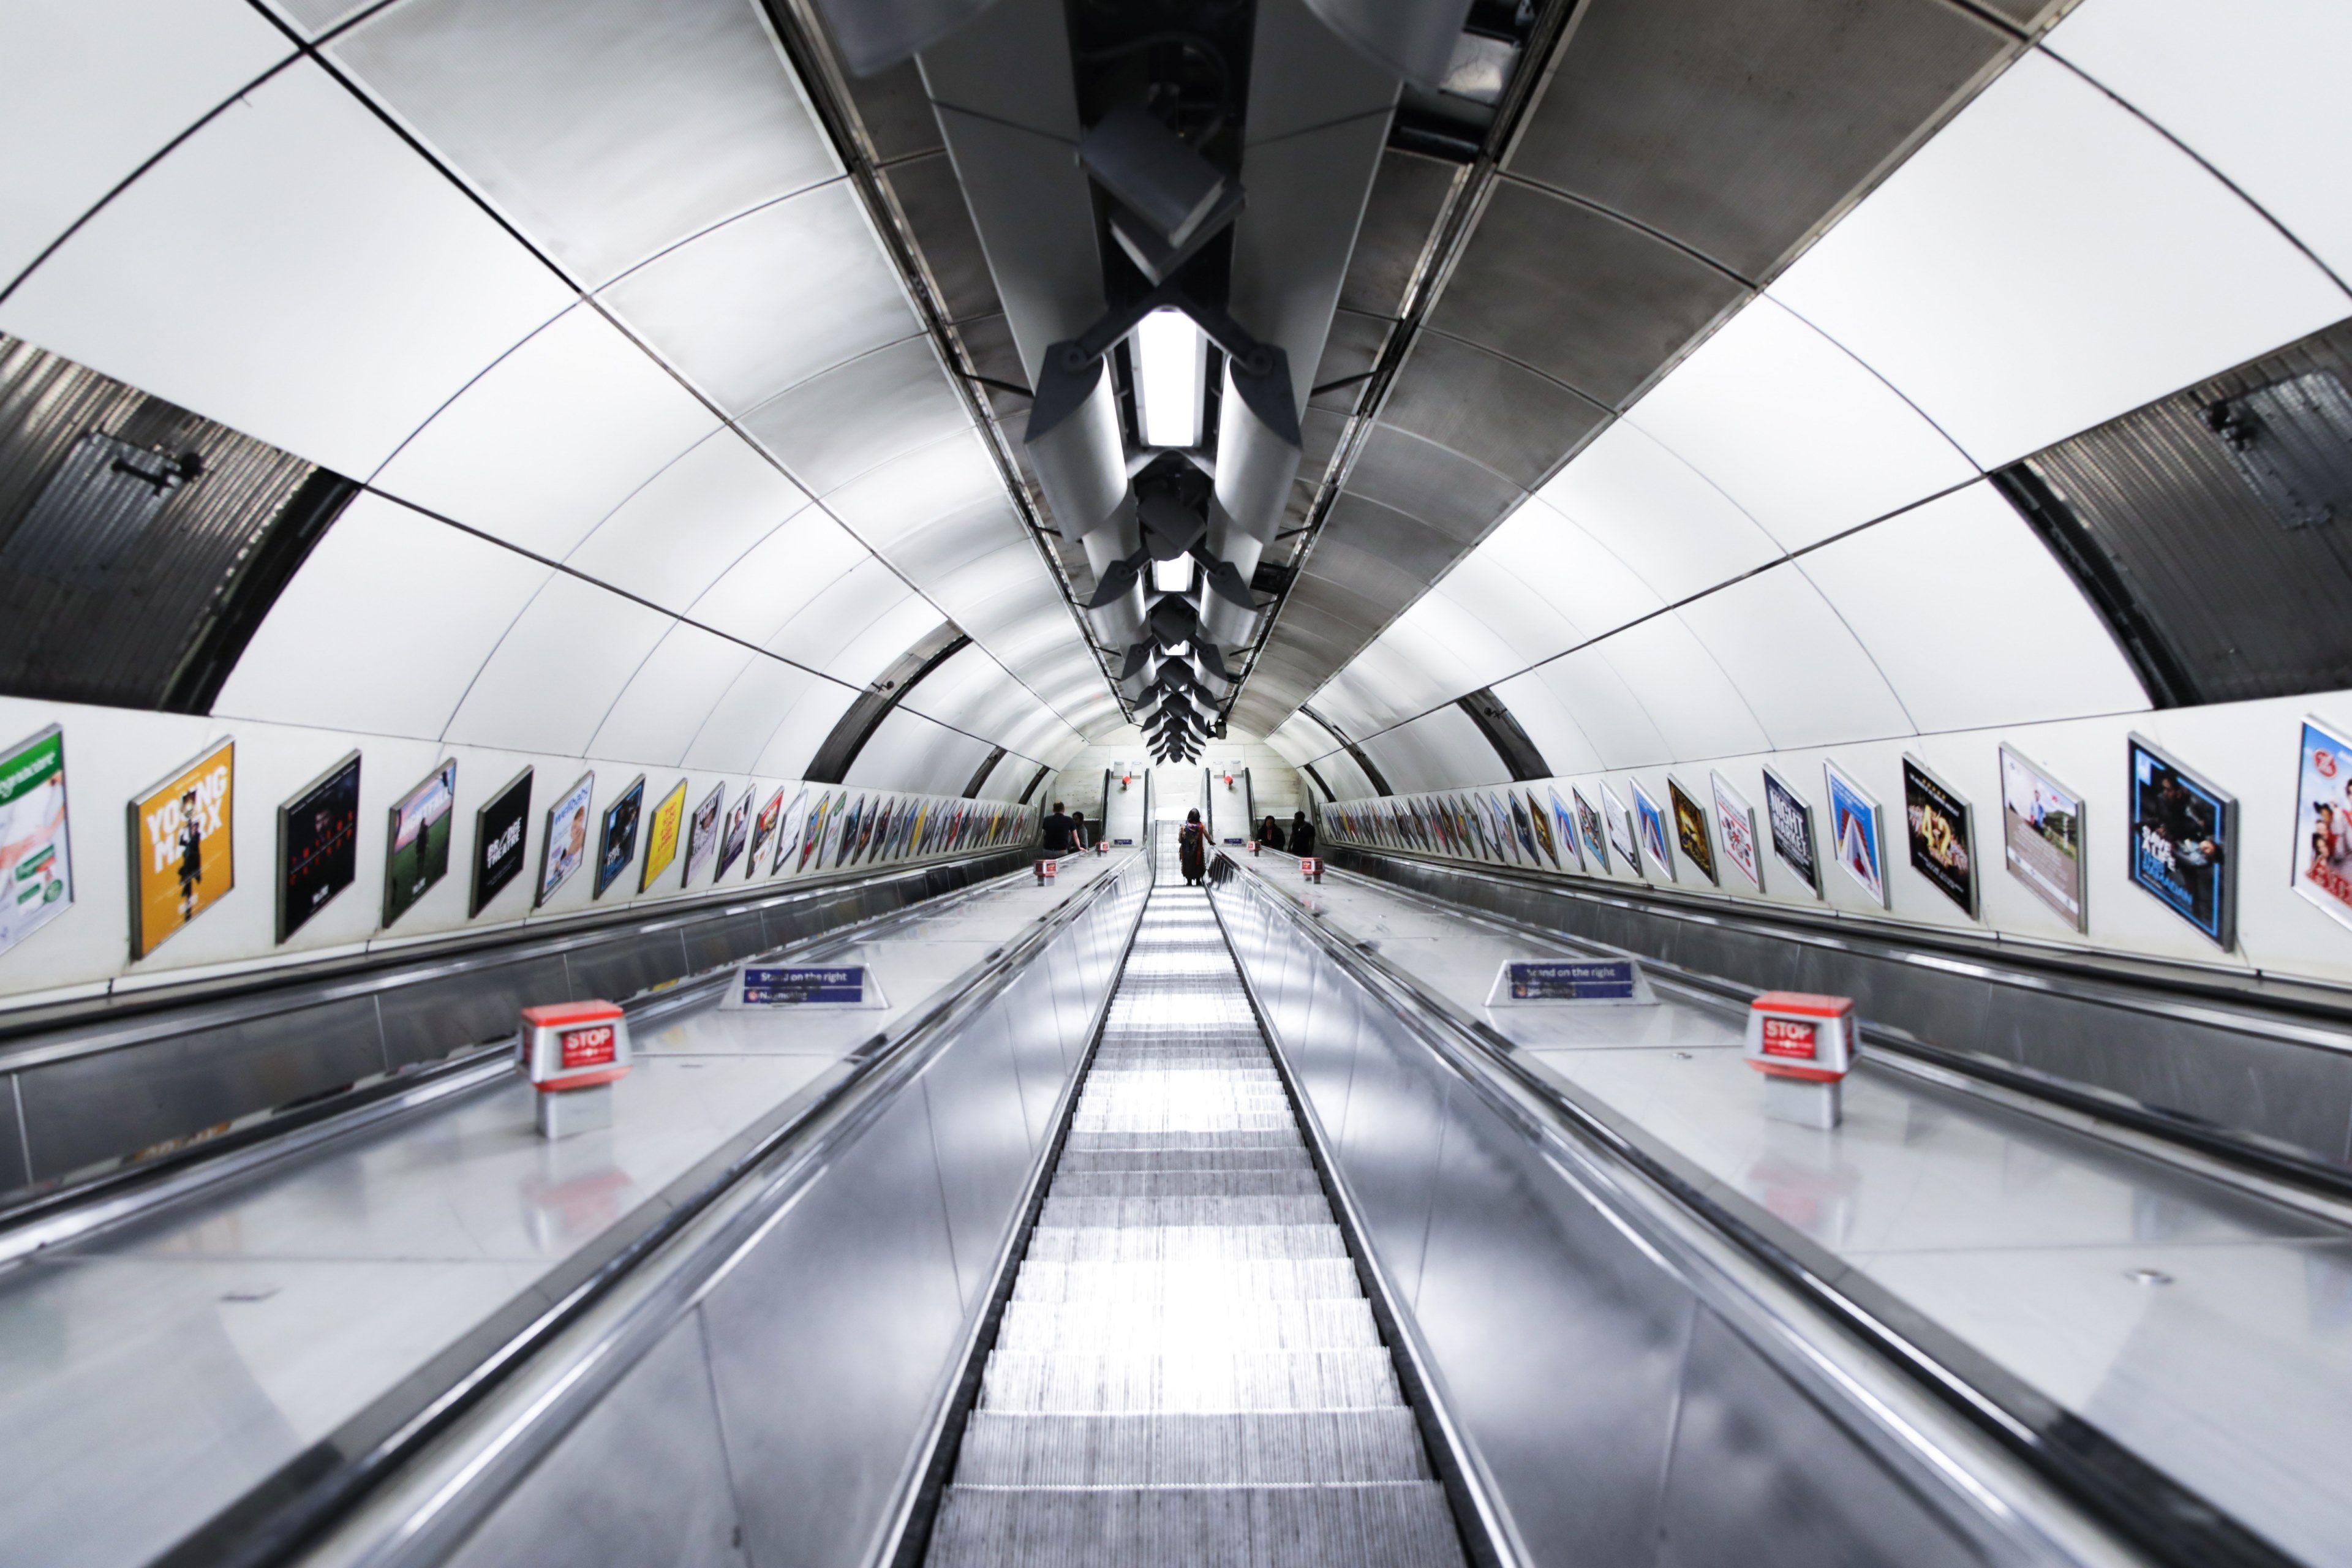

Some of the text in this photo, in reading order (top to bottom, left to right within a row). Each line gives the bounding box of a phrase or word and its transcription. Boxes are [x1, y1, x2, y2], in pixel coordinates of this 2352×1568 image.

[146, 764, 228, 845] YOUNG
[1769, 788, 1804, 840] NIGHT
[154, 799, 222, 874] MARX
[760, 971, 848, 984] Std on the right
[1571, 968, 1589, 977] the
[1591, 967, 1616, 979] right
[567, 1027, 611, 1050] STOP
[1766, 1019, 1812, 1040] STOP
